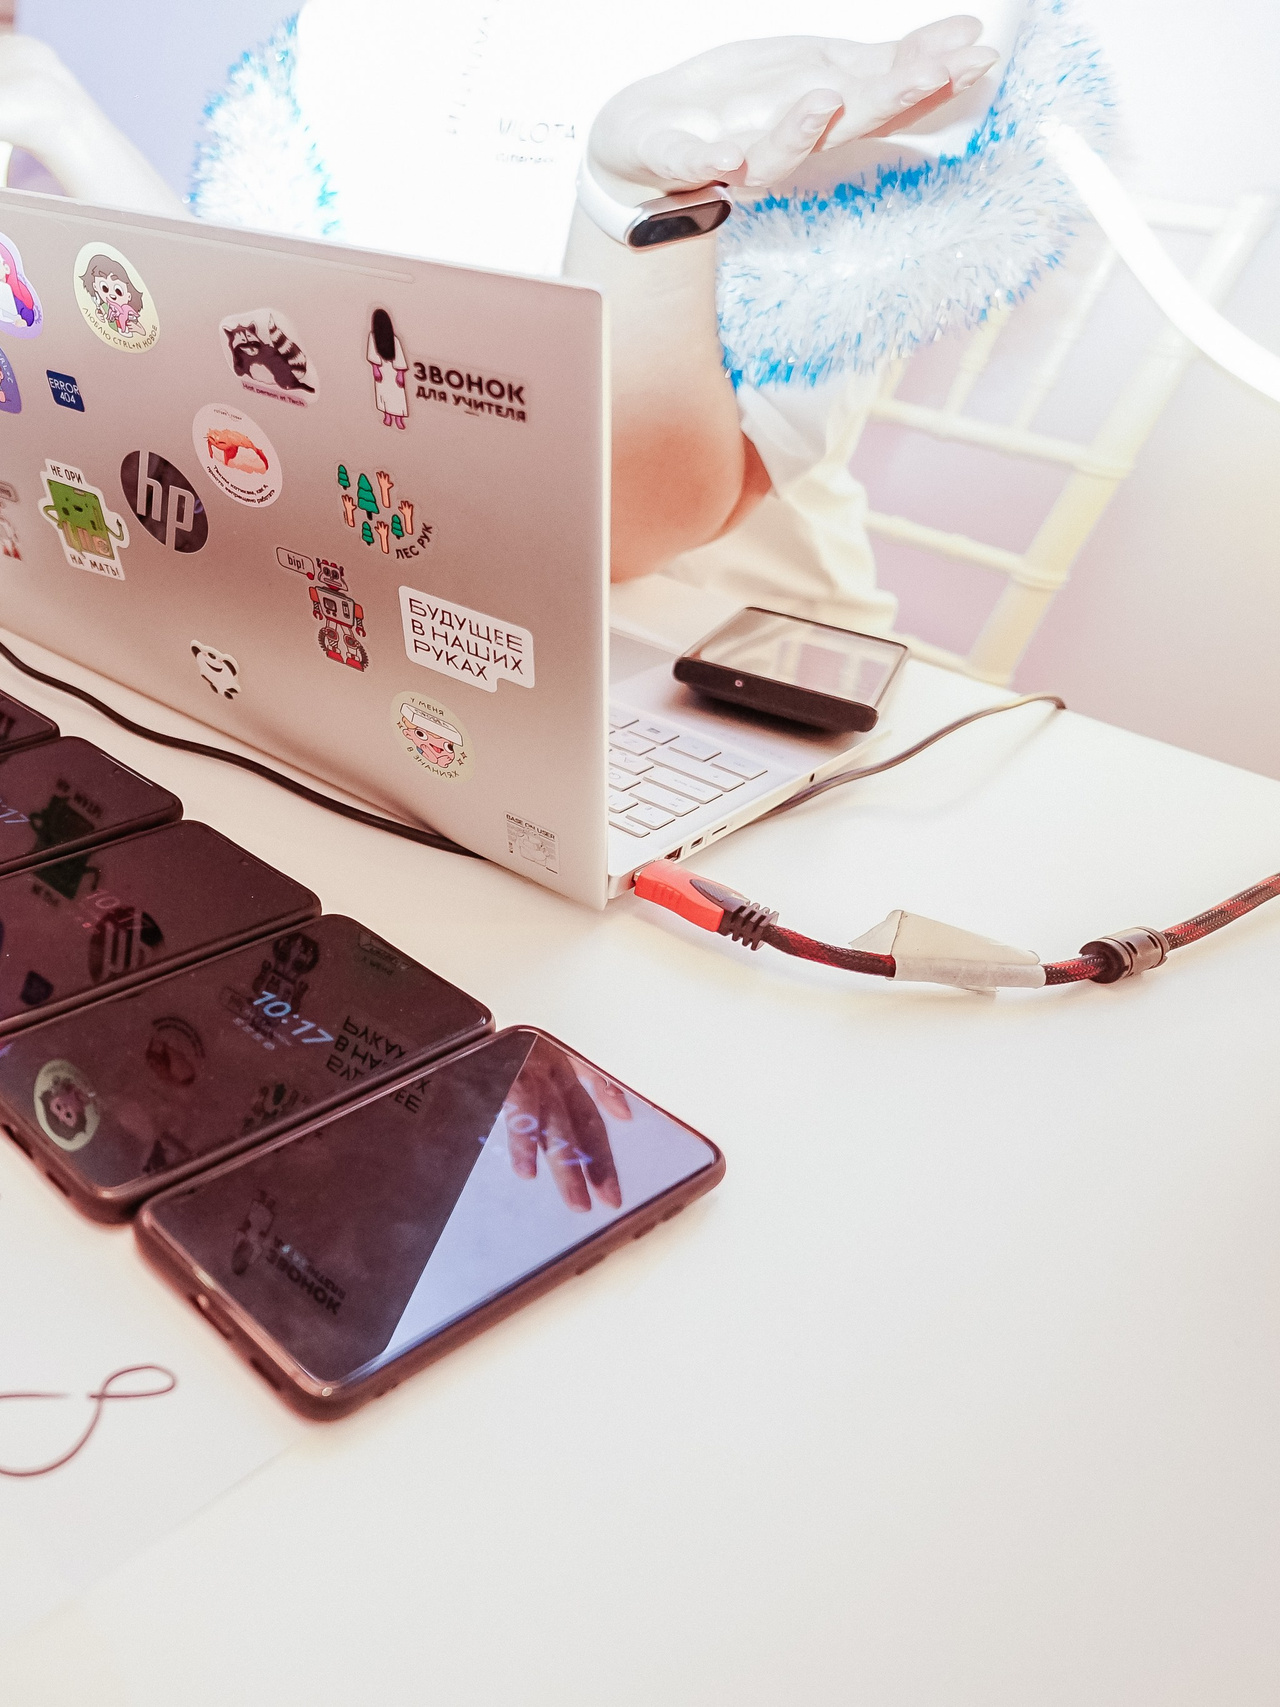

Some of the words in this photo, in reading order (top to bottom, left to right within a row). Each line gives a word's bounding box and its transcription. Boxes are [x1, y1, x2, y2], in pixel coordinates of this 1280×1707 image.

[143, 324, 159, 348] НОВОЕ
[48, 377, 80, 396] ERROR
[413, 361, 525, 405] ЗВОНОК
[60, 392, 76, 404] 404
[452, 393, 526, 423] УЧИТЕЛЯ
[50, 465, 63, 478] НЕ
[64, 469, 83, 485] ОРИ
[132, 450, 200, 551] hp
[395, 545, 420, 559] ЛЕС
[417, 522, 433, 549] РУК
[70, 554, 85, 567] НА
[90, 560, 121, 577] МАТЬ!
[287, 553, 305, 570] bip!
[409, 597, 523, 654] БУДУЩЕЕ
[411, 618, 425, 636] В
[431, 625, 523, 675] НАШИХ
[413, 638, 488, 681] РУКАХ
[418, 700, 444, 716] МЕНЯ
[413, 754, 460, 779] ЗНАНИЯХ
[252, 990, 335, 1046] 10:17
